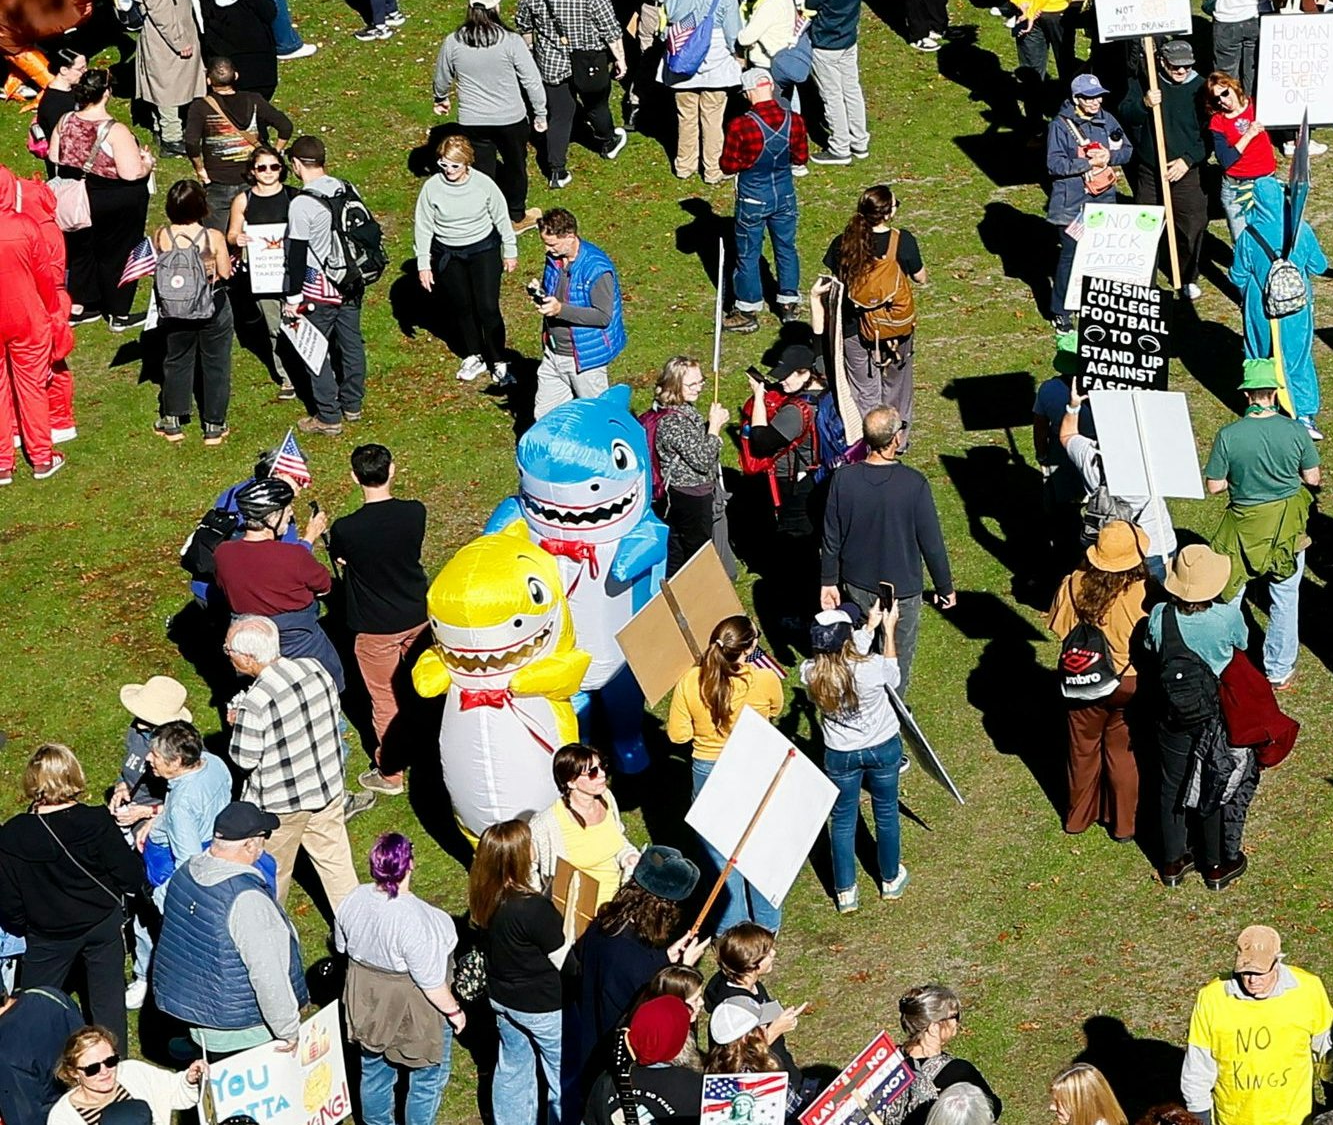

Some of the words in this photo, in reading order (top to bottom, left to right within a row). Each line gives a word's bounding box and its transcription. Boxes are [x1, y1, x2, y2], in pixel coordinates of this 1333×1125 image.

[1115, 5, 1134, 15] NOT
[1273, 23, 1330, 41] HUMAN
[1271, 43, 1329, 60] RIGHTS
[1271, 60, 1329, 76] BELONG
[1282, 74, 1328, 89] EVERY
[1285, 89, 1315, 105] ONE
[1104, 213, 1129, 231] NO
[1092, 232, 1141, 250] DICK
[1085, 252, 1146, 267] TATORS
[1089, 277, 1161, 303] MISSING
[1086, 291, 1160, 319] COLLEGE
[1080, 305, 1169, 335] FOOTBALL
[1109, 329, 1132, 345] TO
[1081, 345, 1135, 365] STAND
[1140, 353, 1164, 370] UP
[1085, 361, 1157, 384] AGAINST
[1235, 1025, 1272, 1055] NO
[211, 1063, 270, 1102] YOU
[1232, 1060, 1293, 1092] KINGS
